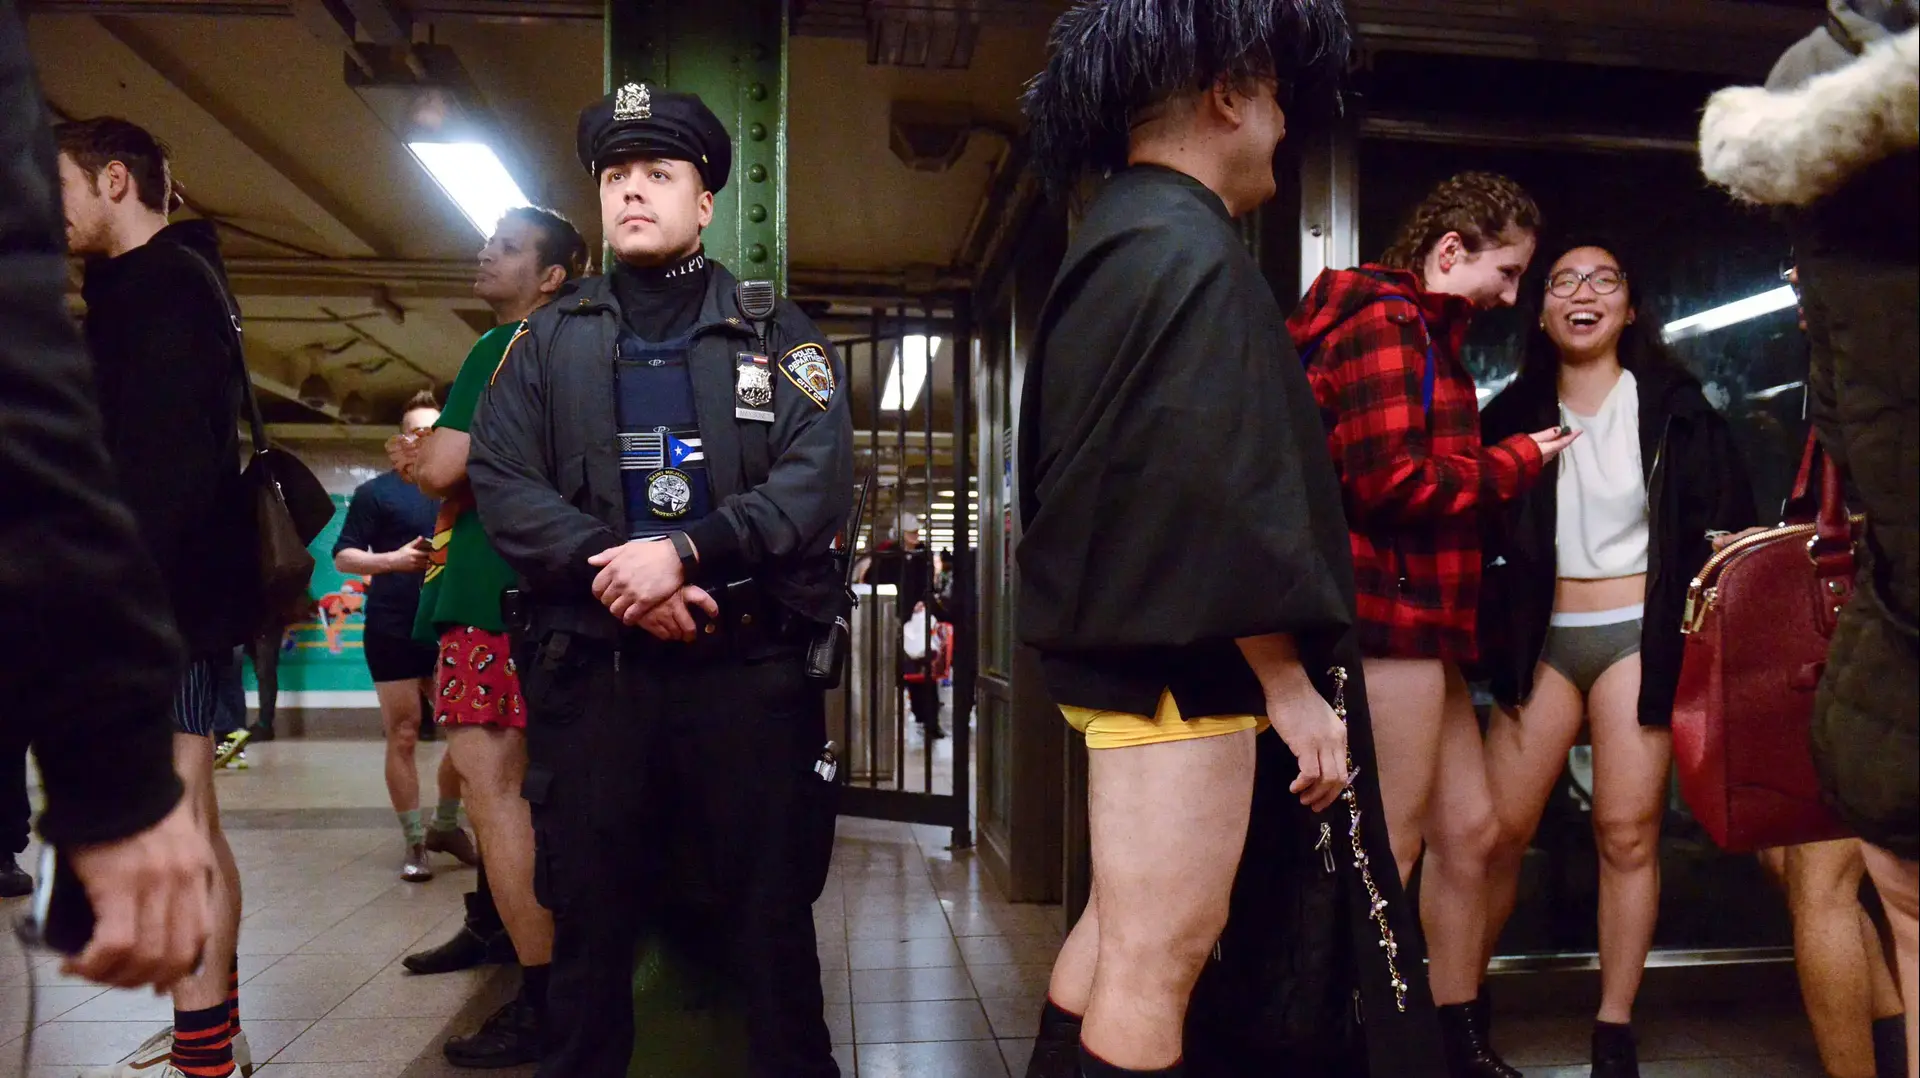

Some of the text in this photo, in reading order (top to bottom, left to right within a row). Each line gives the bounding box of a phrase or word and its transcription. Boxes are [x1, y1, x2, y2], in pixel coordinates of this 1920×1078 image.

[792, 348, 817, 360] POLICE
[796, 378, 812, 392] CITY
[651, 507, 677, 517] PROTECT
